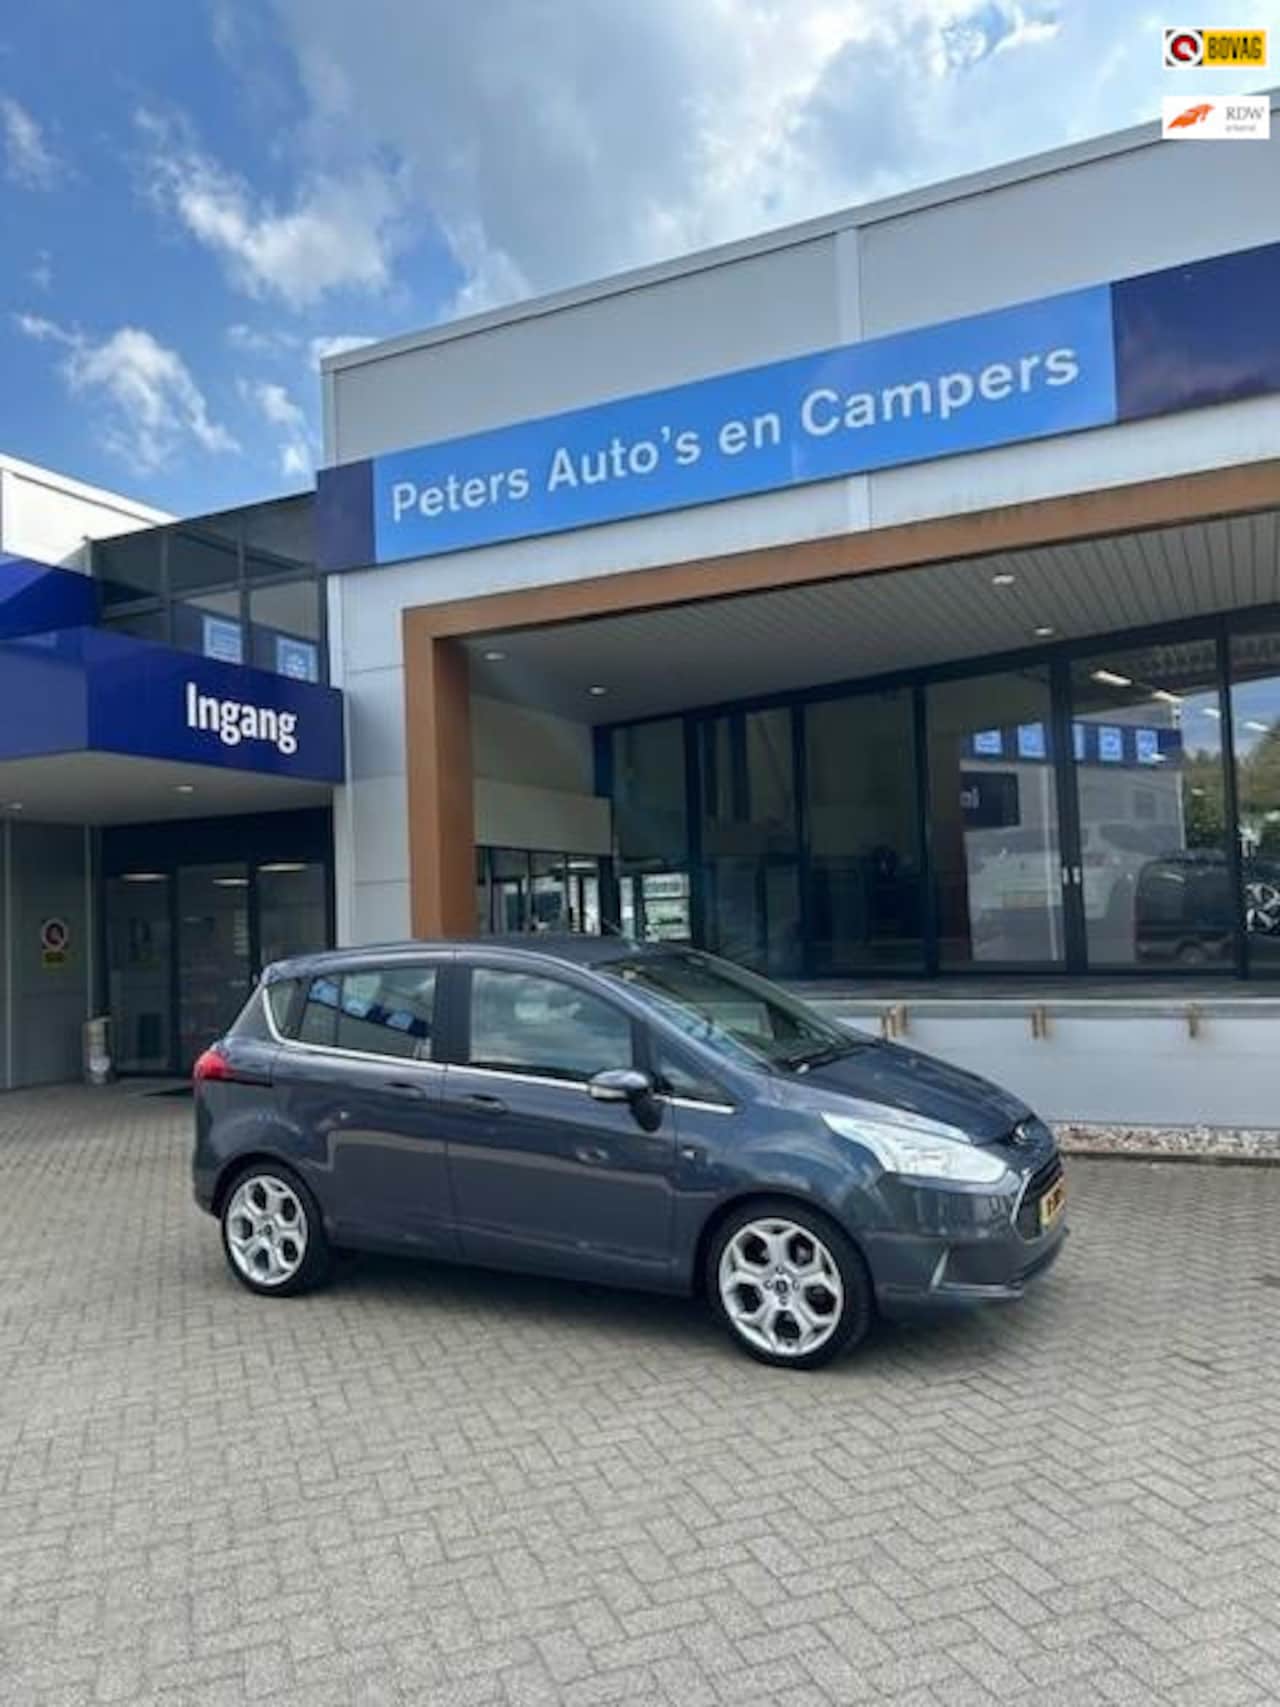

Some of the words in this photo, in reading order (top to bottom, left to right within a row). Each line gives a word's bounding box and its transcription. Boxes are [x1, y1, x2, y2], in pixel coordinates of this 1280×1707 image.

[391, 465, 529, 521] Peters
[548, 426, 701, 492] Auto's
[718, 412, 782, 454] en
[801, 347, 1079, 436] Campers
[186, 682, 298, 755] Ingang
